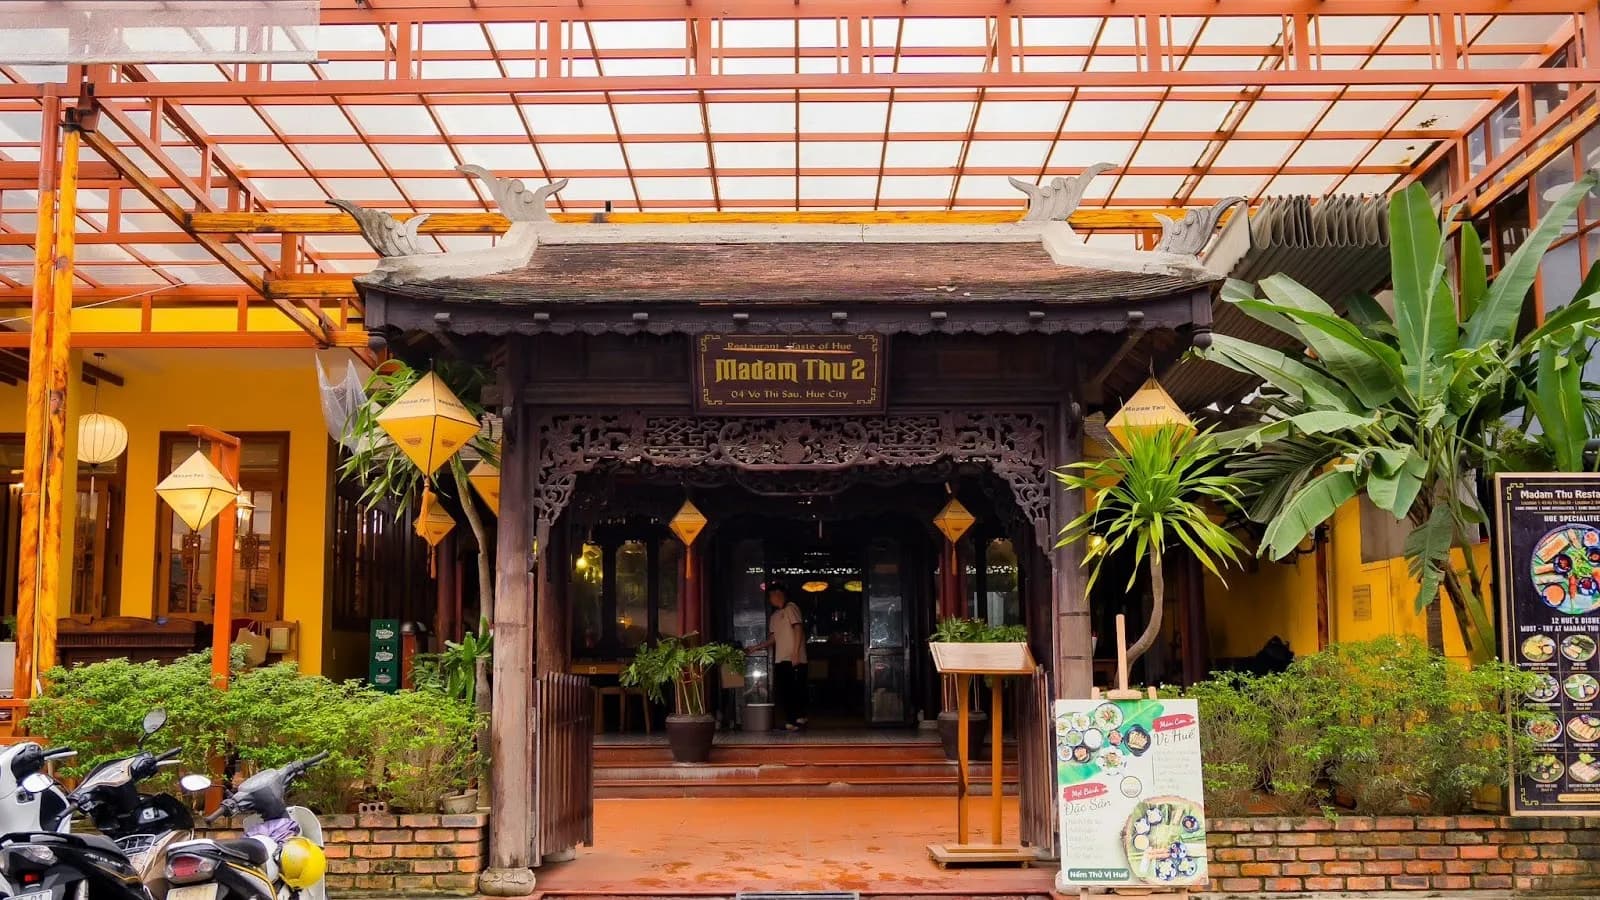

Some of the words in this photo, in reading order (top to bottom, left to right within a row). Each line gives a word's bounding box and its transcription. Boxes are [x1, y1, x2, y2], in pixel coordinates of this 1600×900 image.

[727, 342, 779, 350] Restaurant
[818, 342, 829, 350] of
[832, 342, 852, 350] Hue
[715, 359, 799, 383] Madam
[802, 359, 845, 383] Thu
[851, 359, 865, 380] 2
[731, 391, 744, 399] 04
[748, 391, 761, 399] Vo
[764, 391, 779, 399] Thi
[806, 391, 825, 399] Hue
[828, 390, 848, 400] City
[1520, 490, 1553, 499] Madam
[1554, 490, 1573, 499] Thu
[1112, 870, 1128, 878] Huế
